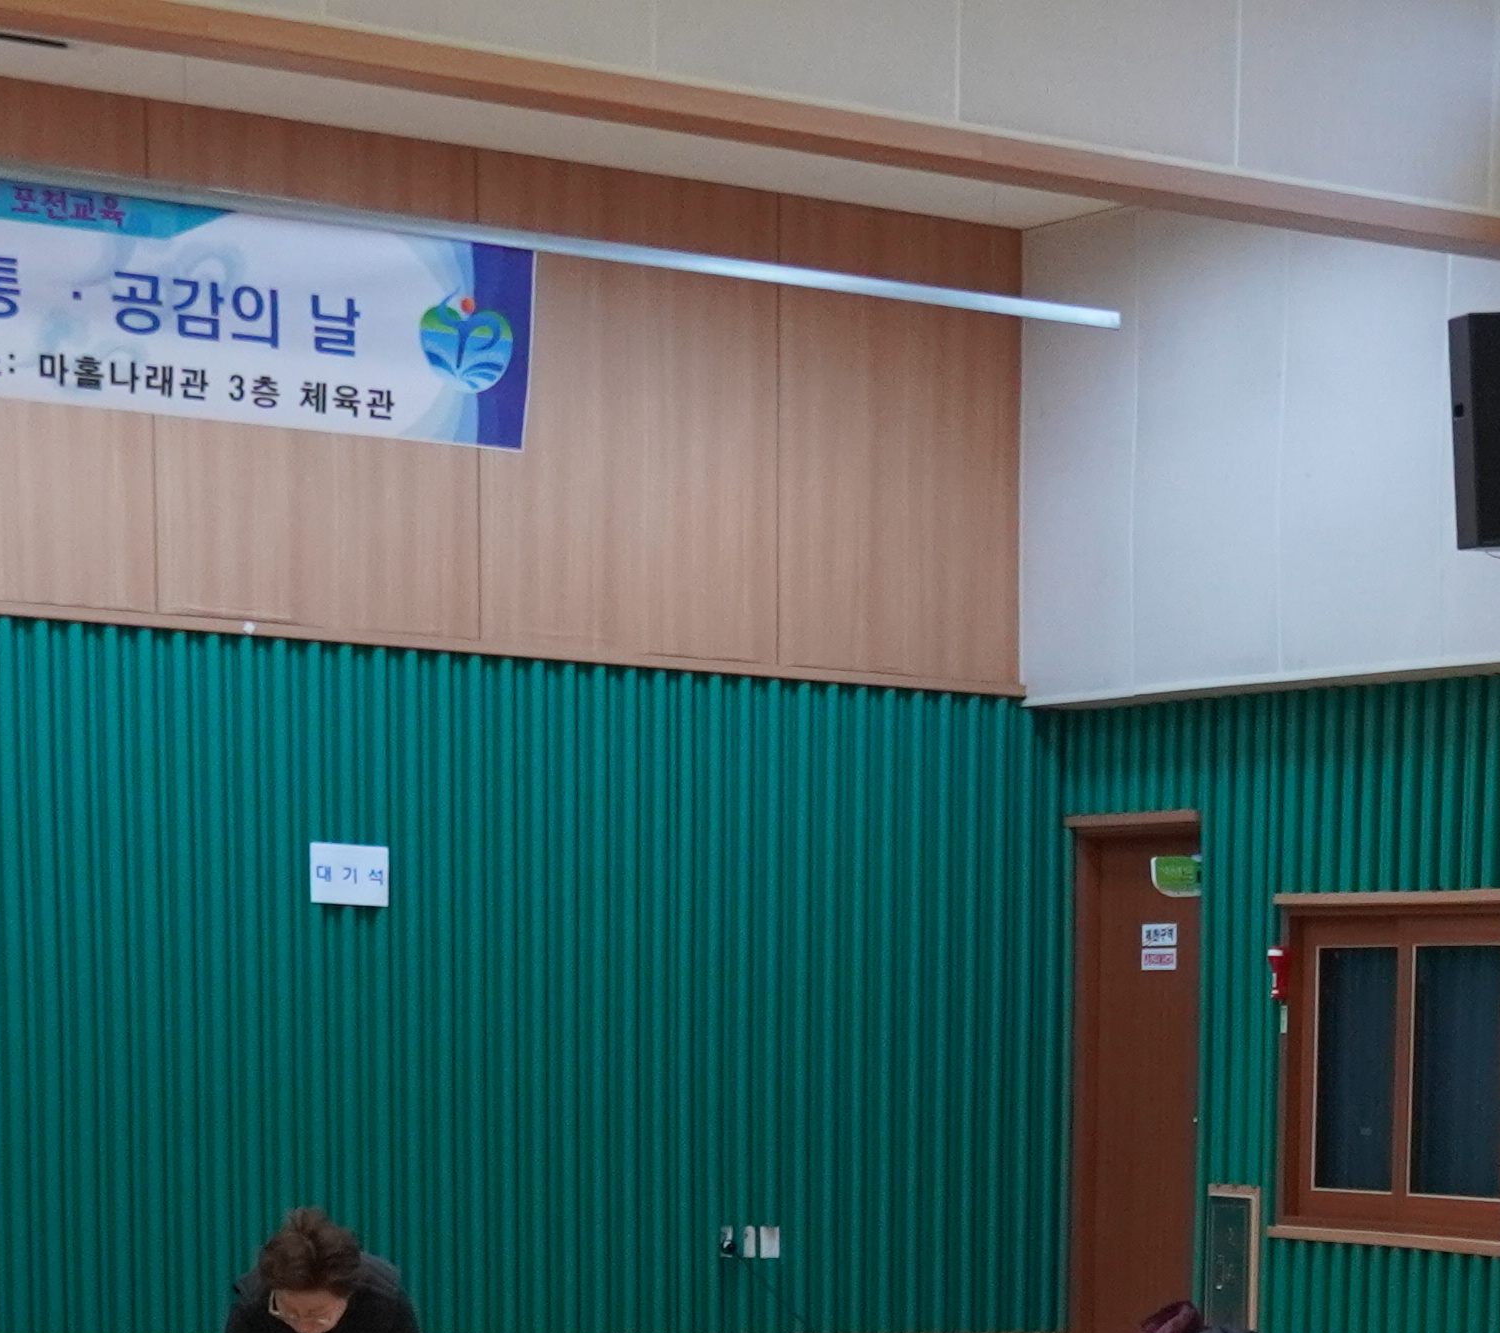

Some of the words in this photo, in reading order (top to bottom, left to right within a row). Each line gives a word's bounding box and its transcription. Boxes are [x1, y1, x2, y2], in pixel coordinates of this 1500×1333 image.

[11, 187, 126, 228] 포천교육
[112, 269, 281, 349] 공감의
[311, 293, 361, 357] 날
[37, 353, 210, 401] 마홀나래관
[228, 374, 280, 409] 3층
[300, 380, 396, 421] 체육관
